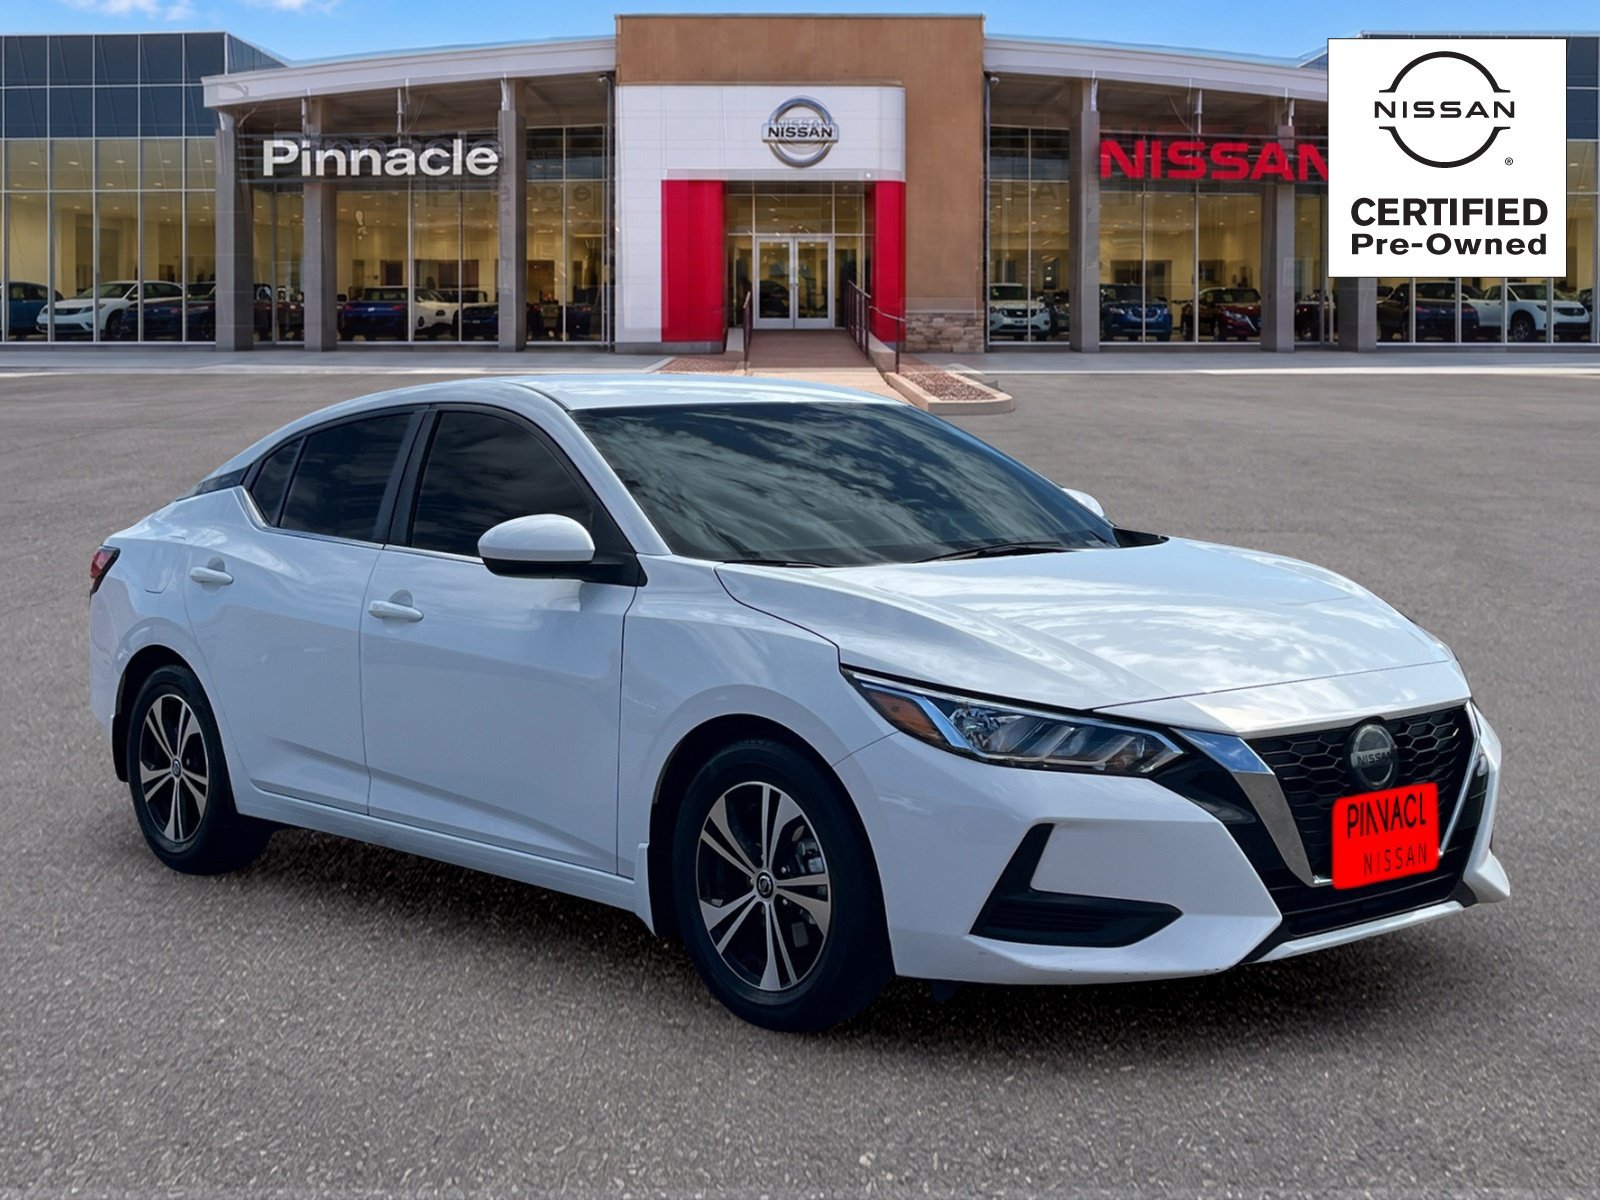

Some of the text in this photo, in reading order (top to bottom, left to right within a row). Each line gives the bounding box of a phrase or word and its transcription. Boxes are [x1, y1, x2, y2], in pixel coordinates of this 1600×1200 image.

[768, 126, 833, 138] NISSAN
[263, 139, 498, 176] Pinnacle
[1101, 140, 1328, 181] NISSAN
[1363, 842, 1427, 875] NISSAN
